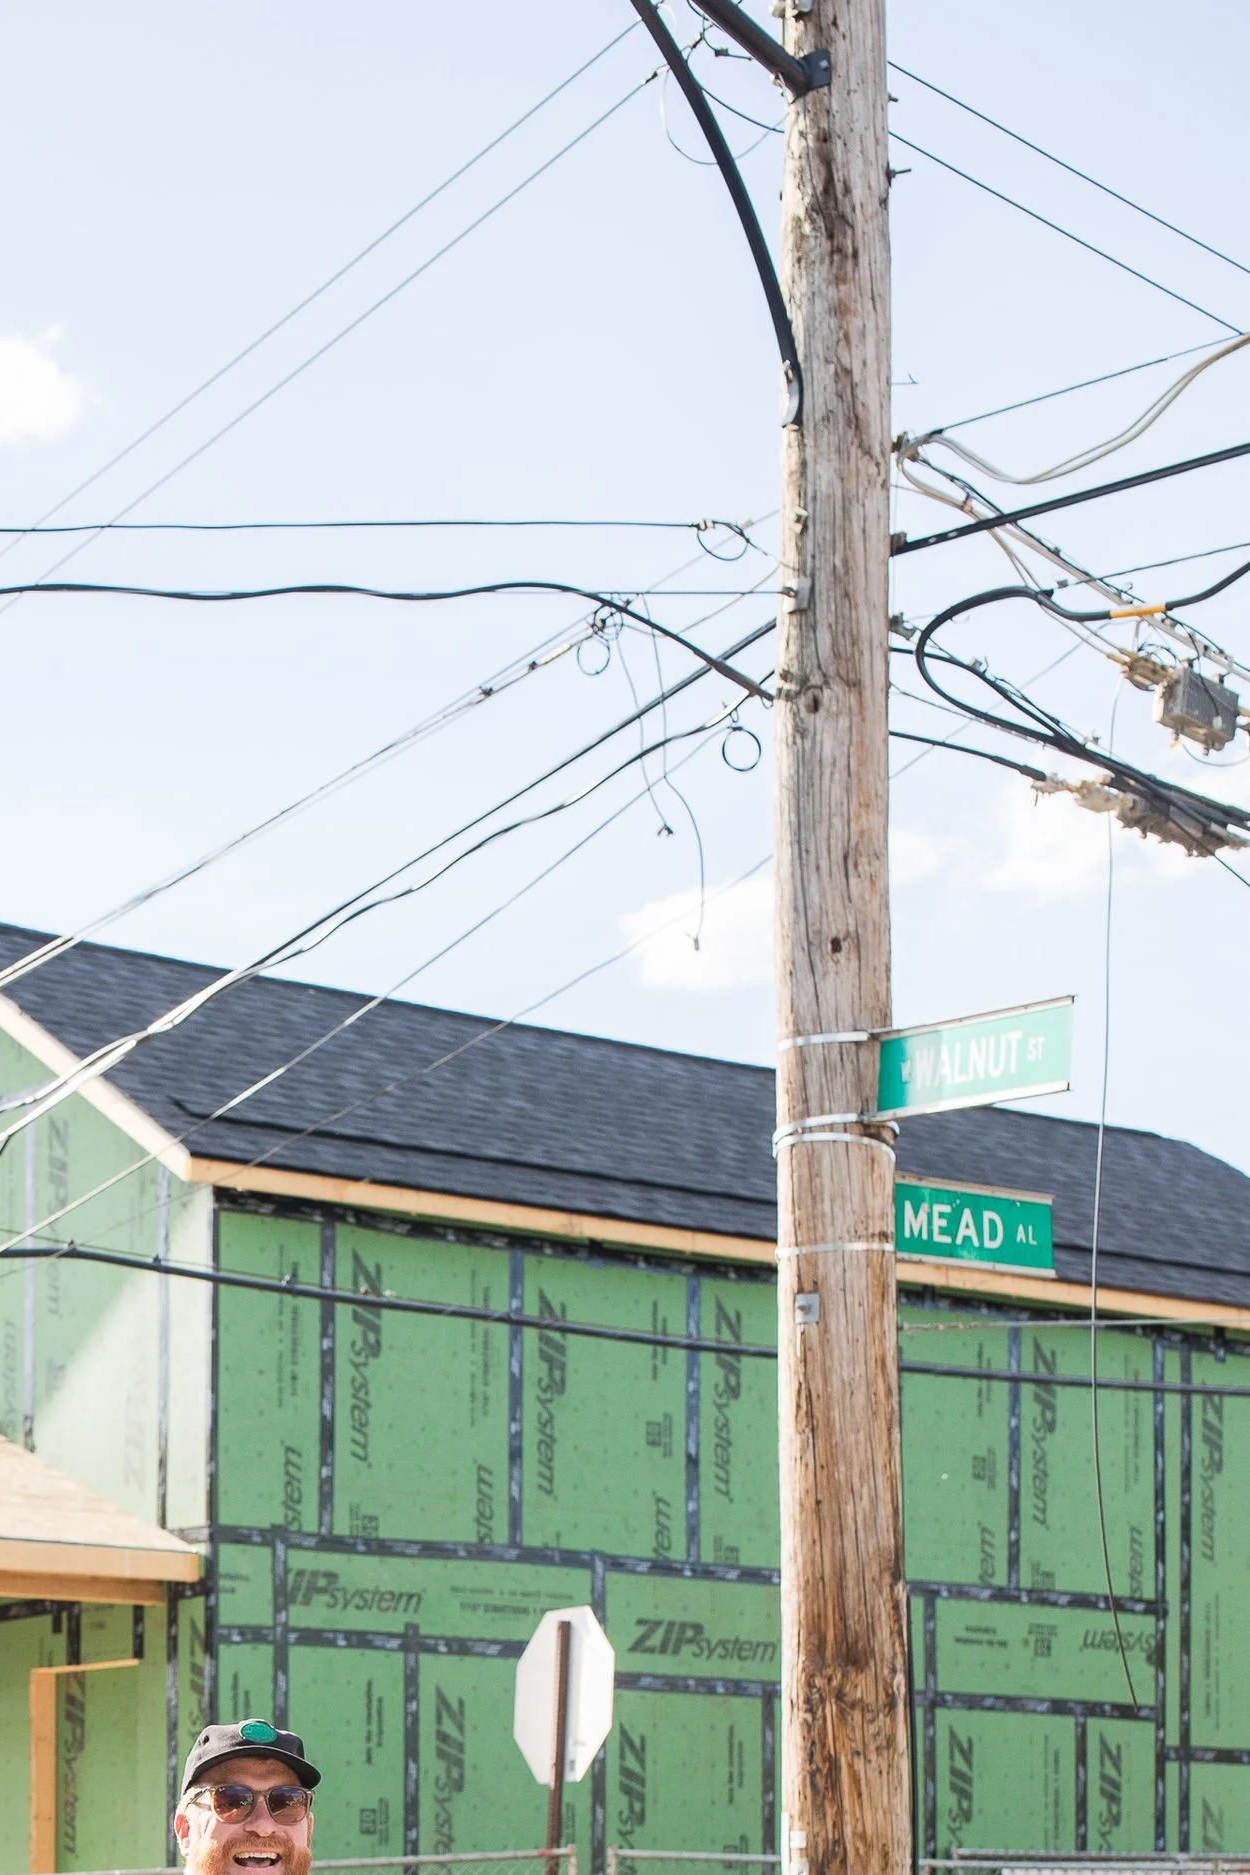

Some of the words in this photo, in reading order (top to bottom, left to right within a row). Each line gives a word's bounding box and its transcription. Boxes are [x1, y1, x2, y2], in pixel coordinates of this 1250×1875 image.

[914, 1031, 1023, 1089] WALNUT
[1027, 1036, 1045, 1061] ST
[904, 1201, 1005, 1249] MEAD
[1016, 1223, 1038, 1246] AL
[286, 1567, 422, 1615] IPsystem
